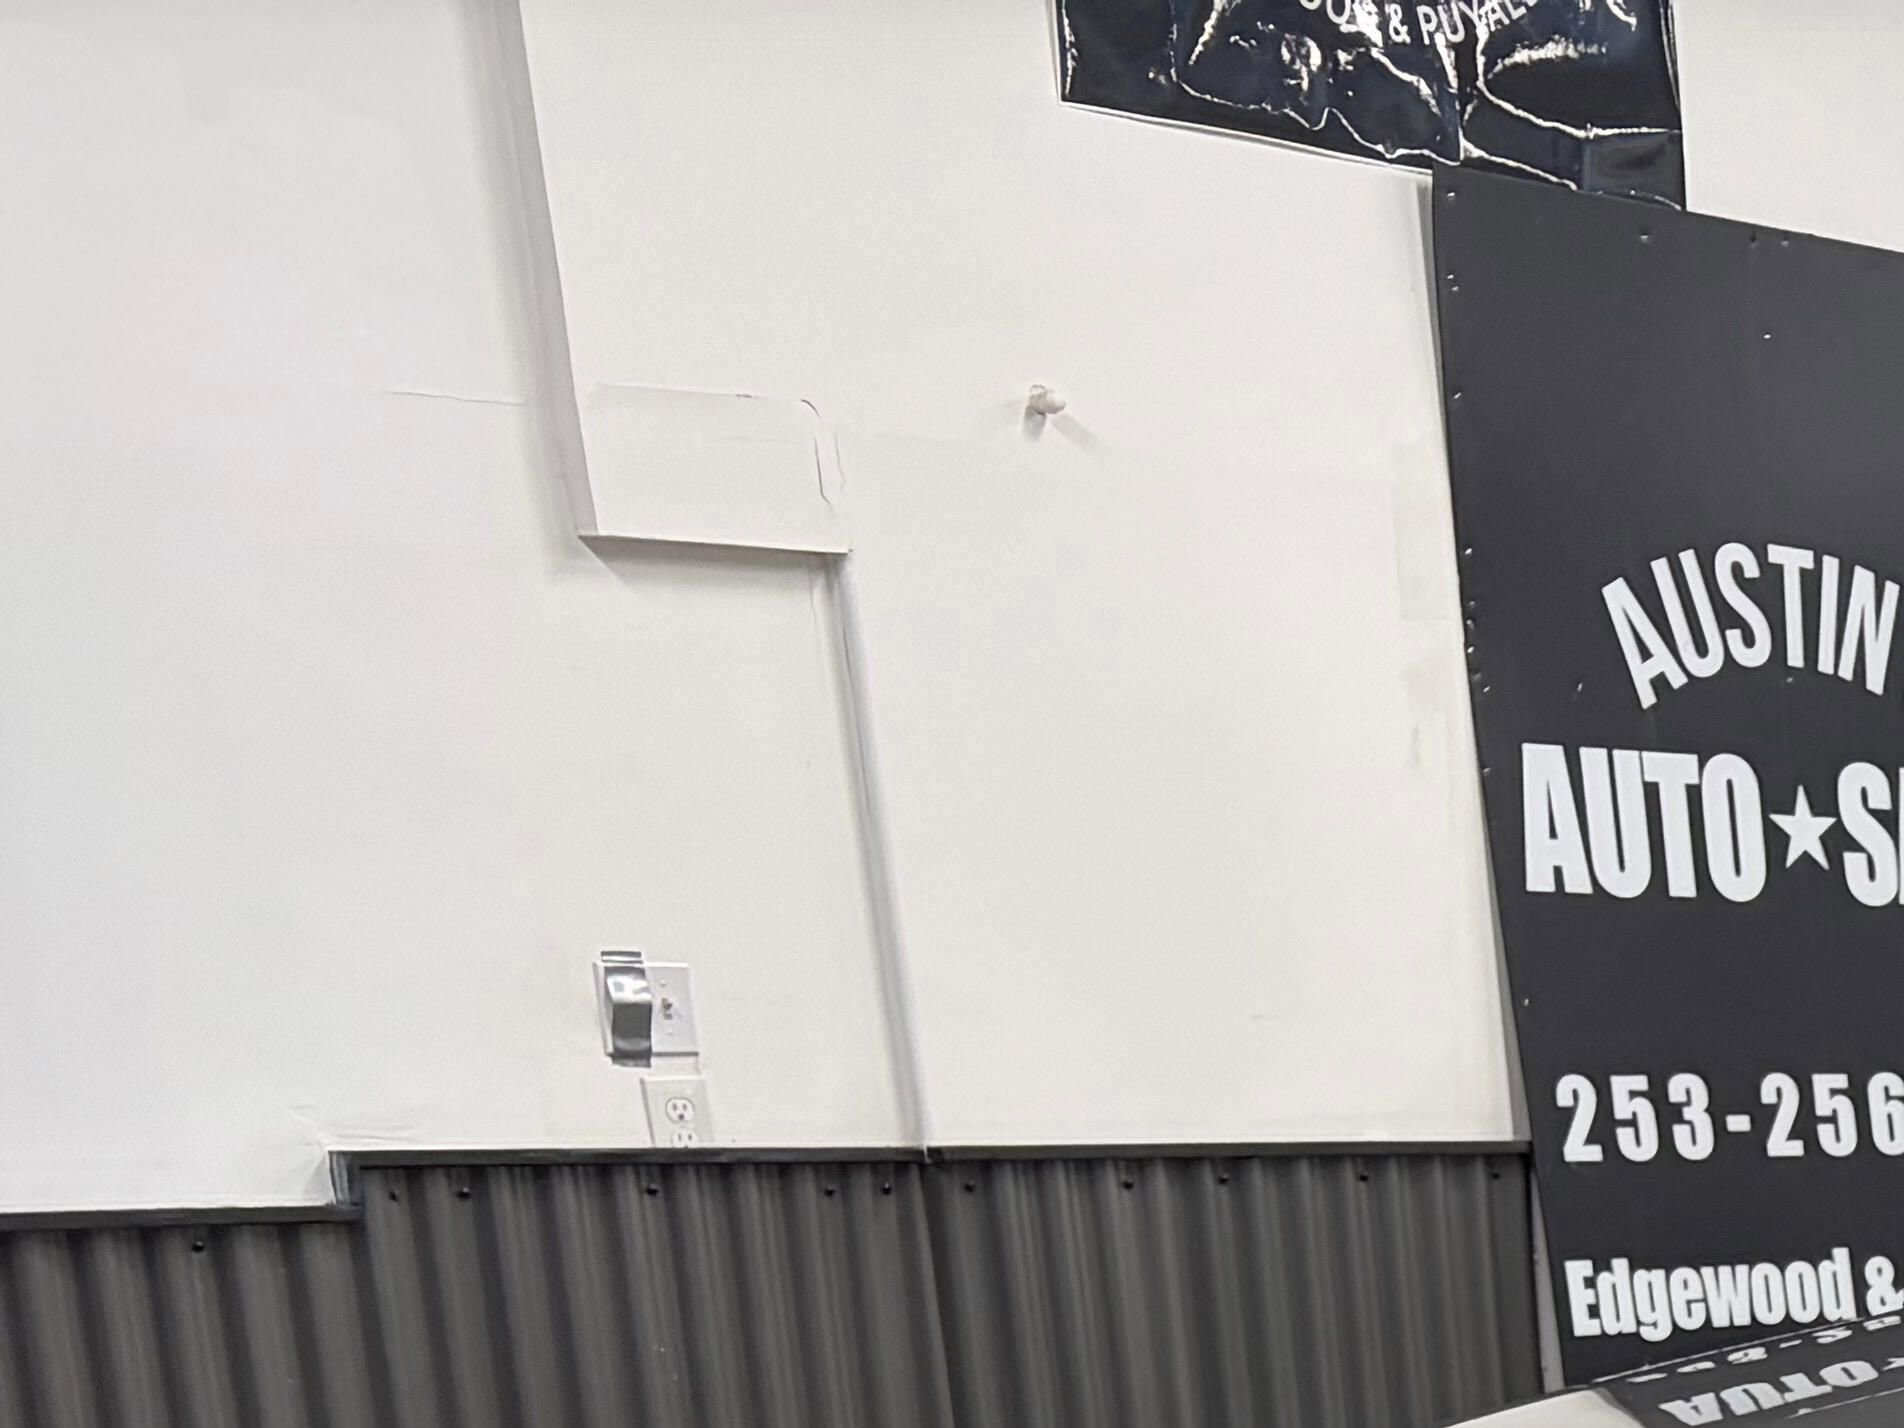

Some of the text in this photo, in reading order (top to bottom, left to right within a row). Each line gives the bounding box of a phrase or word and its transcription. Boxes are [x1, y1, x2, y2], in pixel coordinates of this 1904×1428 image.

[1389, 3, 1411, 44] &
[1521, 742, 1768, 903] AUTO
[1564, 1246, 1861, 1342] Edgewood
